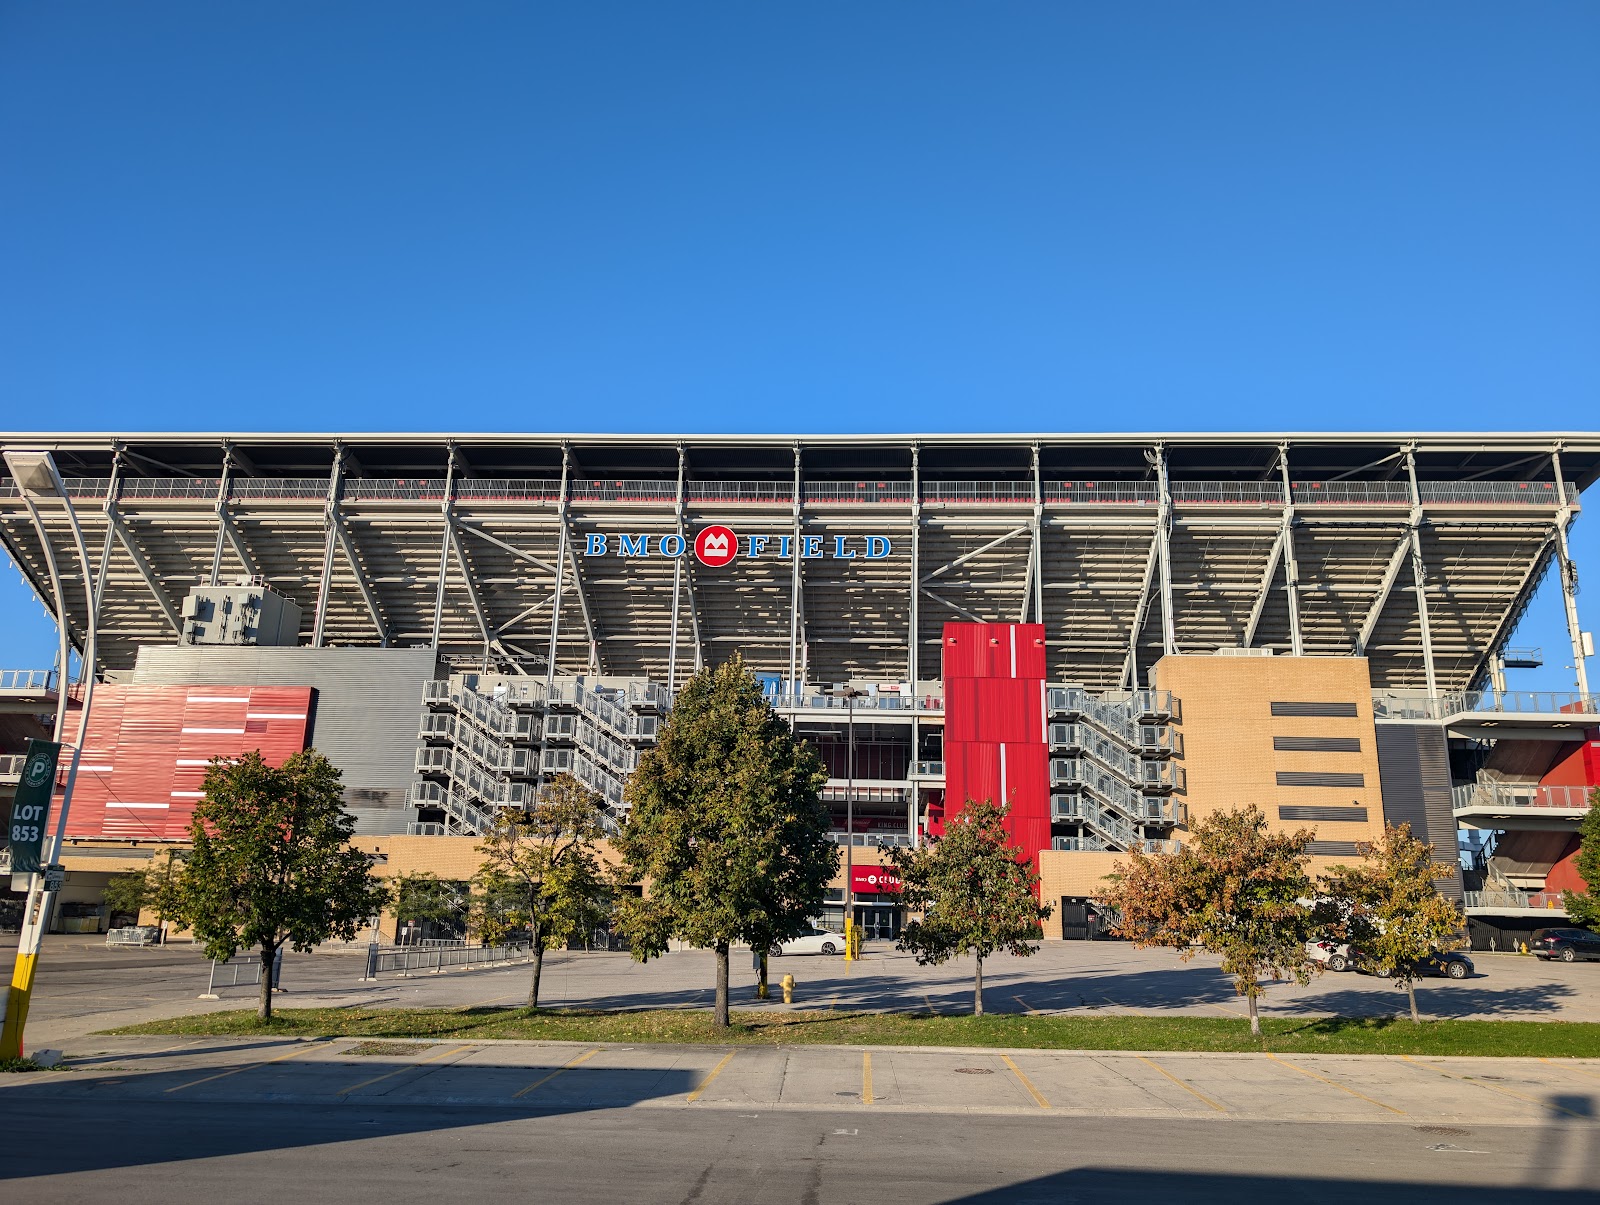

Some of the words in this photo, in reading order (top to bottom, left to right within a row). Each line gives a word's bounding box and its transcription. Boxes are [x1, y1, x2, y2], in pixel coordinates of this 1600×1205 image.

[584, 533, 687, 557] BMO
[746, 534, 892, 559] FIELD
[14, 805, 43, 821] LOT
[12, 825, 39, 842] 853
